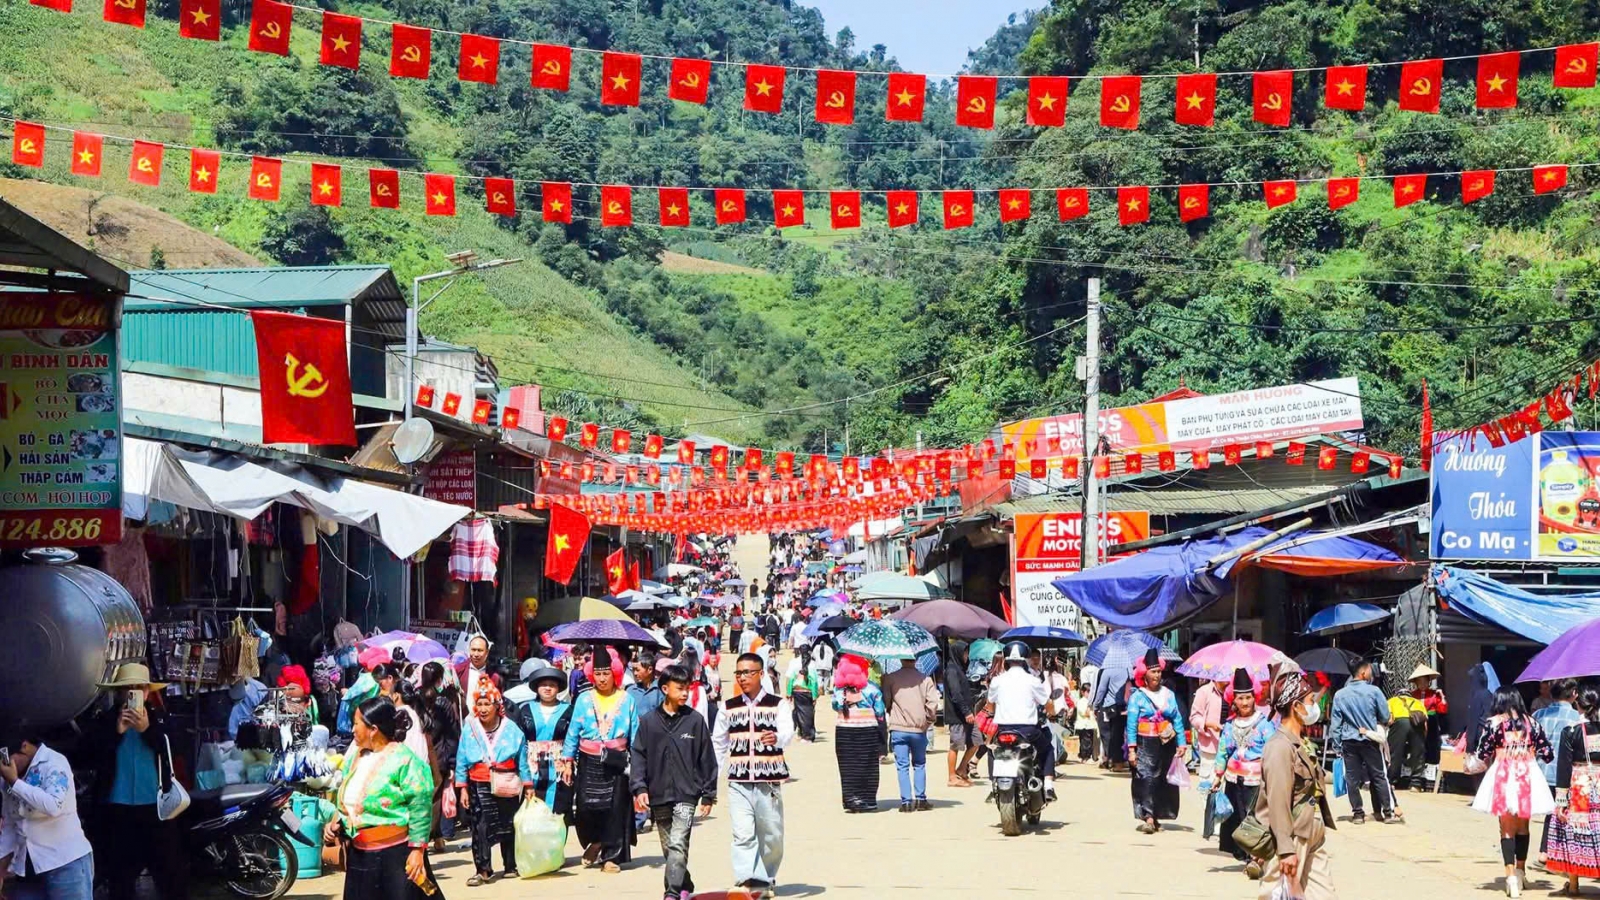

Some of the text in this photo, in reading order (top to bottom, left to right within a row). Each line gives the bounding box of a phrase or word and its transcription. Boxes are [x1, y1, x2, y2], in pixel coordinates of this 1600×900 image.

[66, 350, 109, 369] DÂN
[44, 449, 70, 465] SẢN
[20, 471, 51, 487] THẬP
[1441, 531, 1472, 549] Co
[1479, 531, 1516, 554] Mạ
[1030, 591, 1053, 601] CUNG
